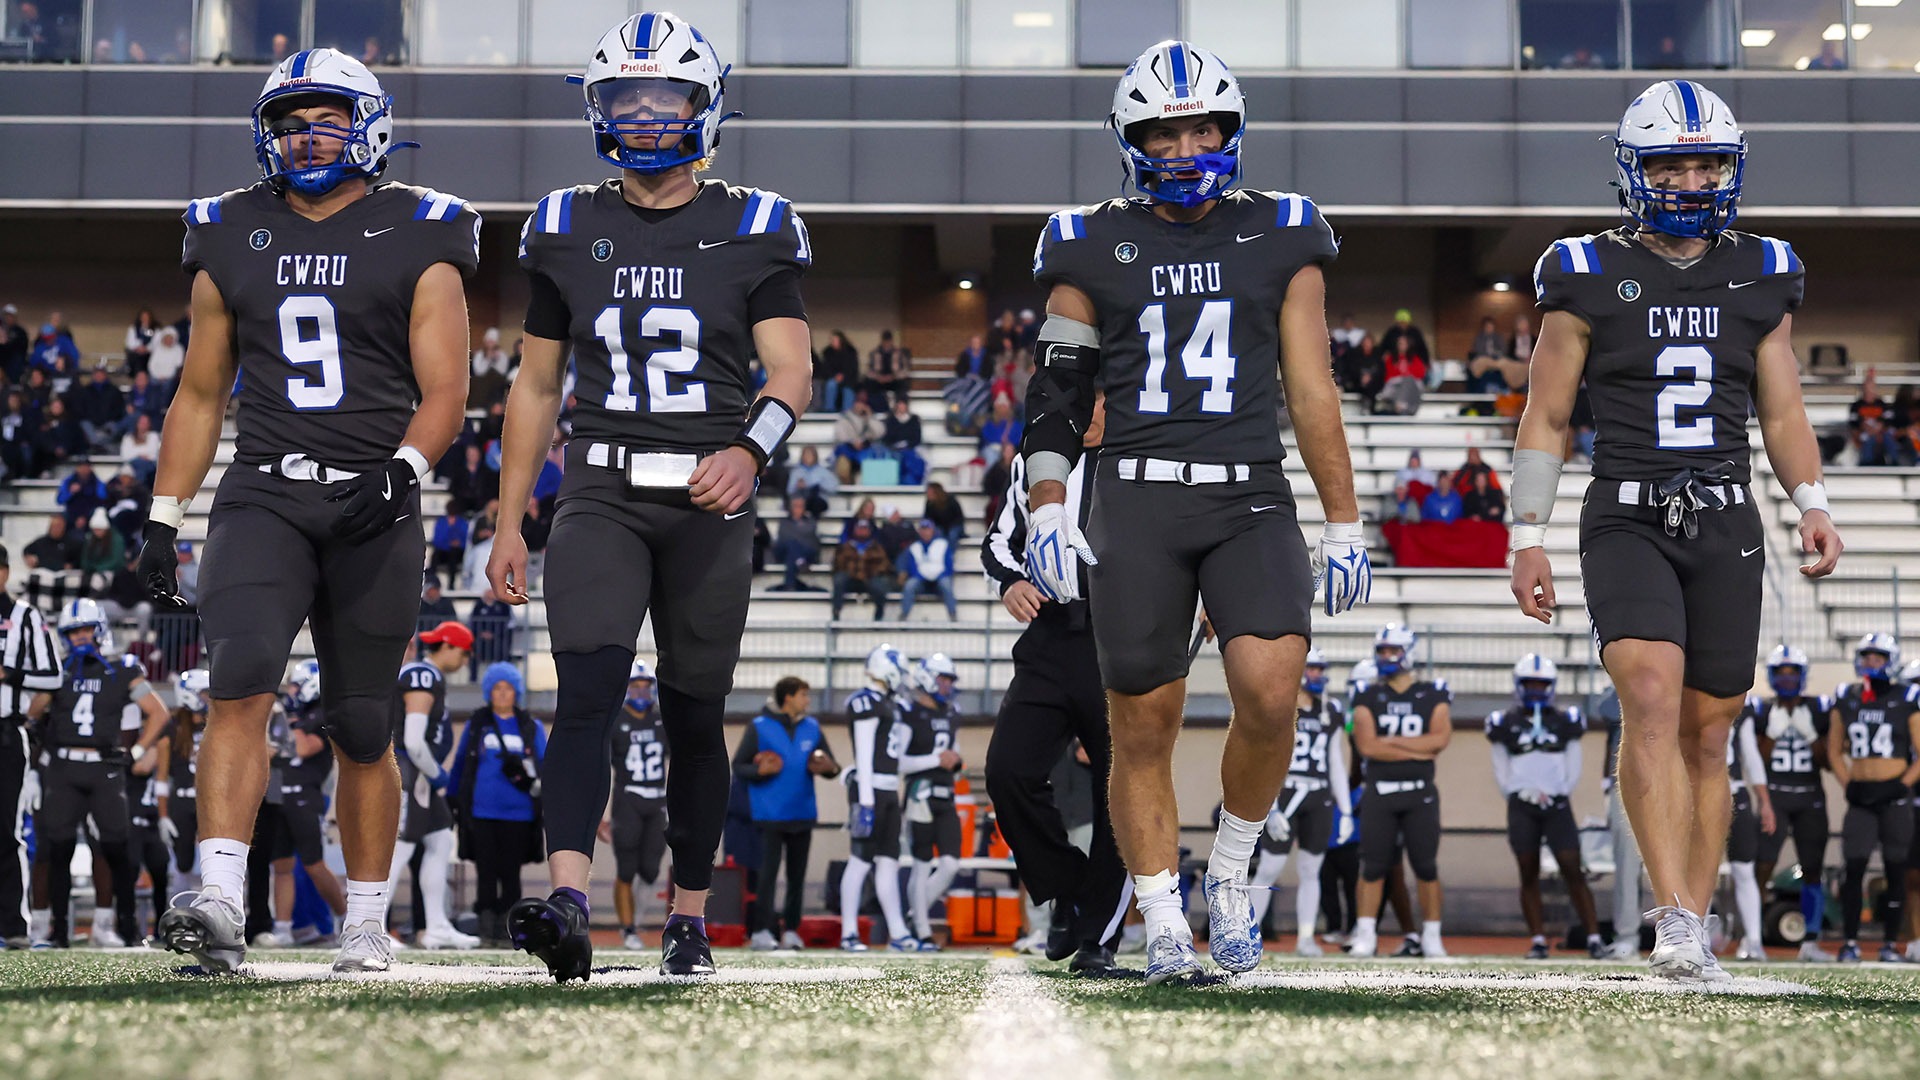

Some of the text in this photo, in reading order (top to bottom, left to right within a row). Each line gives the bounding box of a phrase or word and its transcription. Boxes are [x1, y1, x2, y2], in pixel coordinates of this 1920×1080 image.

[1163, 100, 1204, 113] Riddell
[1677, 135, 1711, 143] Riddell
[276, 254, 348, 286] CWRU
[613, 266, 683, 300] CWRU
[1151, 261, 1222, 297] CWRU
[1648, 306, 1720, 338] CWRU
[277, 293, 346, 411] 9
[593, 304, 708, 413] 12
[1137, 298, 1239, 415] 14
[1655, 343, 1717, 449] 2
[409, 671, 434, 689] 10
[72, 692, 95, 737] 4
[1289, 730, 1329, 772] 24
[1847, 721, 1894, 759] 84
[624, 741, 663, 782] 42
